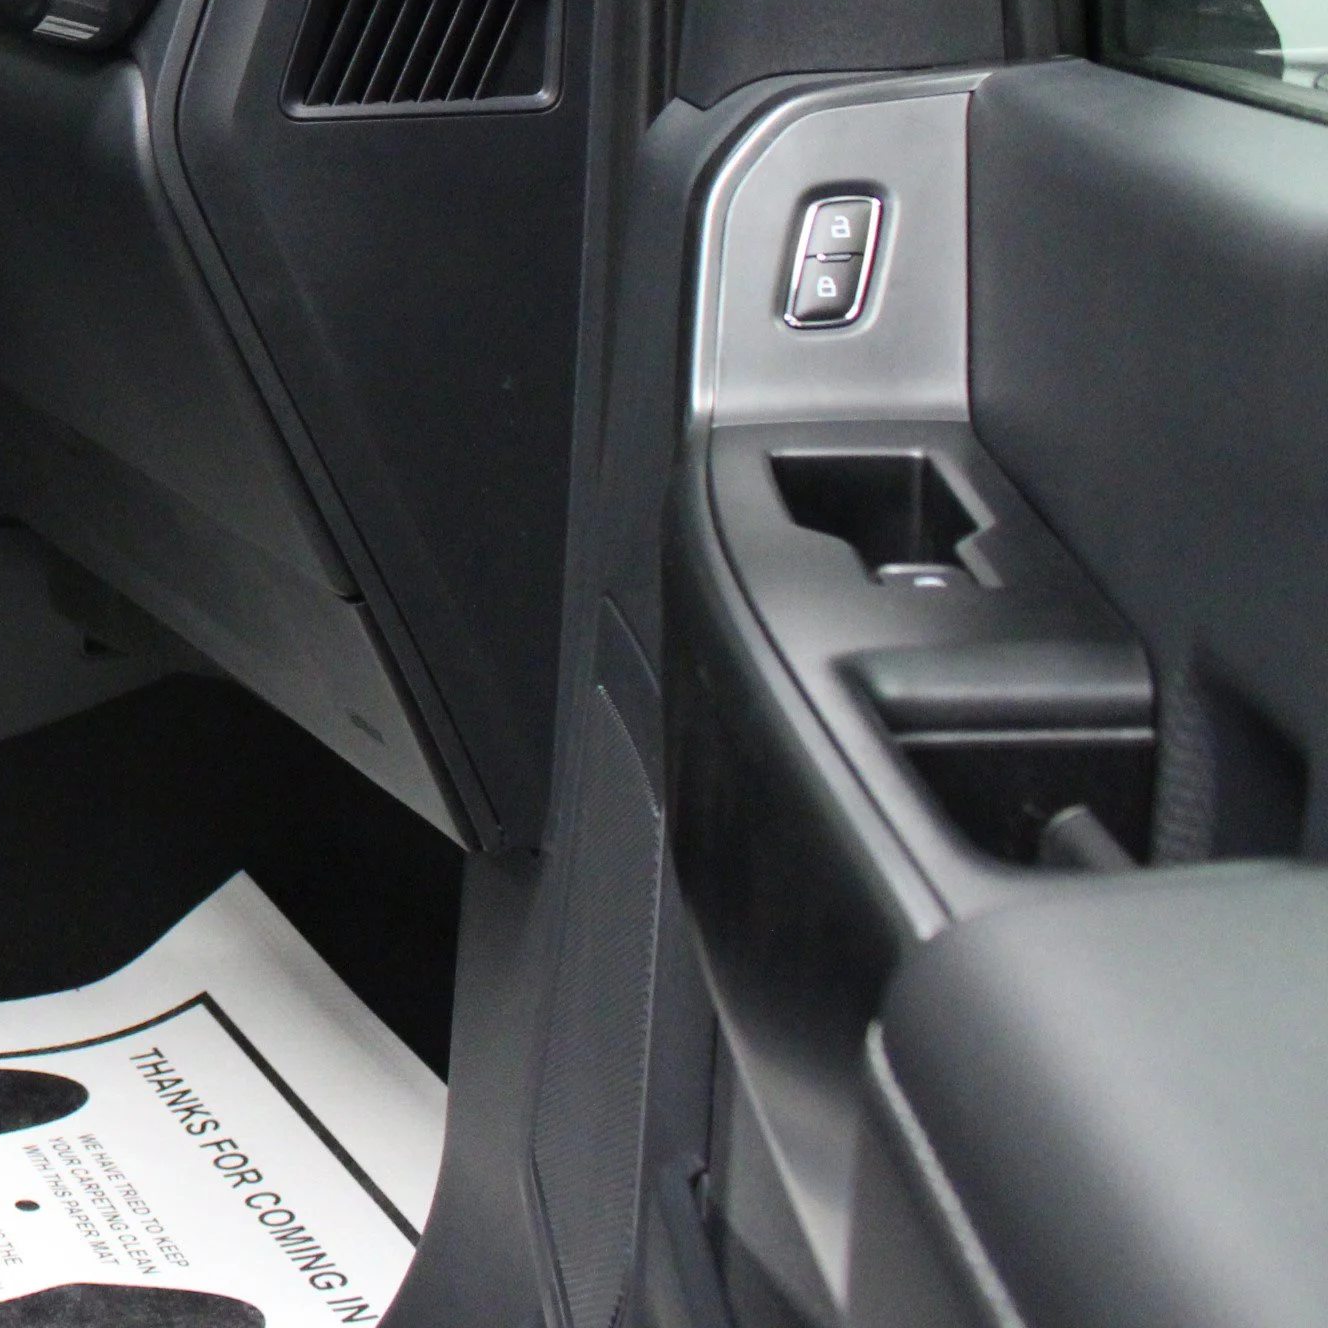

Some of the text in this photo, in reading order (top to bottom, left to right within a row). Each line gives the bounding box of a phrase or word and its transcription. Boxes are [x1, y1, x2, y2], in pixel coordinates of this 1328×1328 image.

[22, 1145, 55, 1171] WITH
[43, 1173, 72, 1198] THIS
[60, 1199, 101, 1238] PAPER
[48, 1136, 162, 1275] YOUR CARPETING CLEAN
[78, 1133, 190, 1268] WE HAVE TRIED TO KEEP
[128, 1046, 379, 1325] THANKS FOR COMING IN
